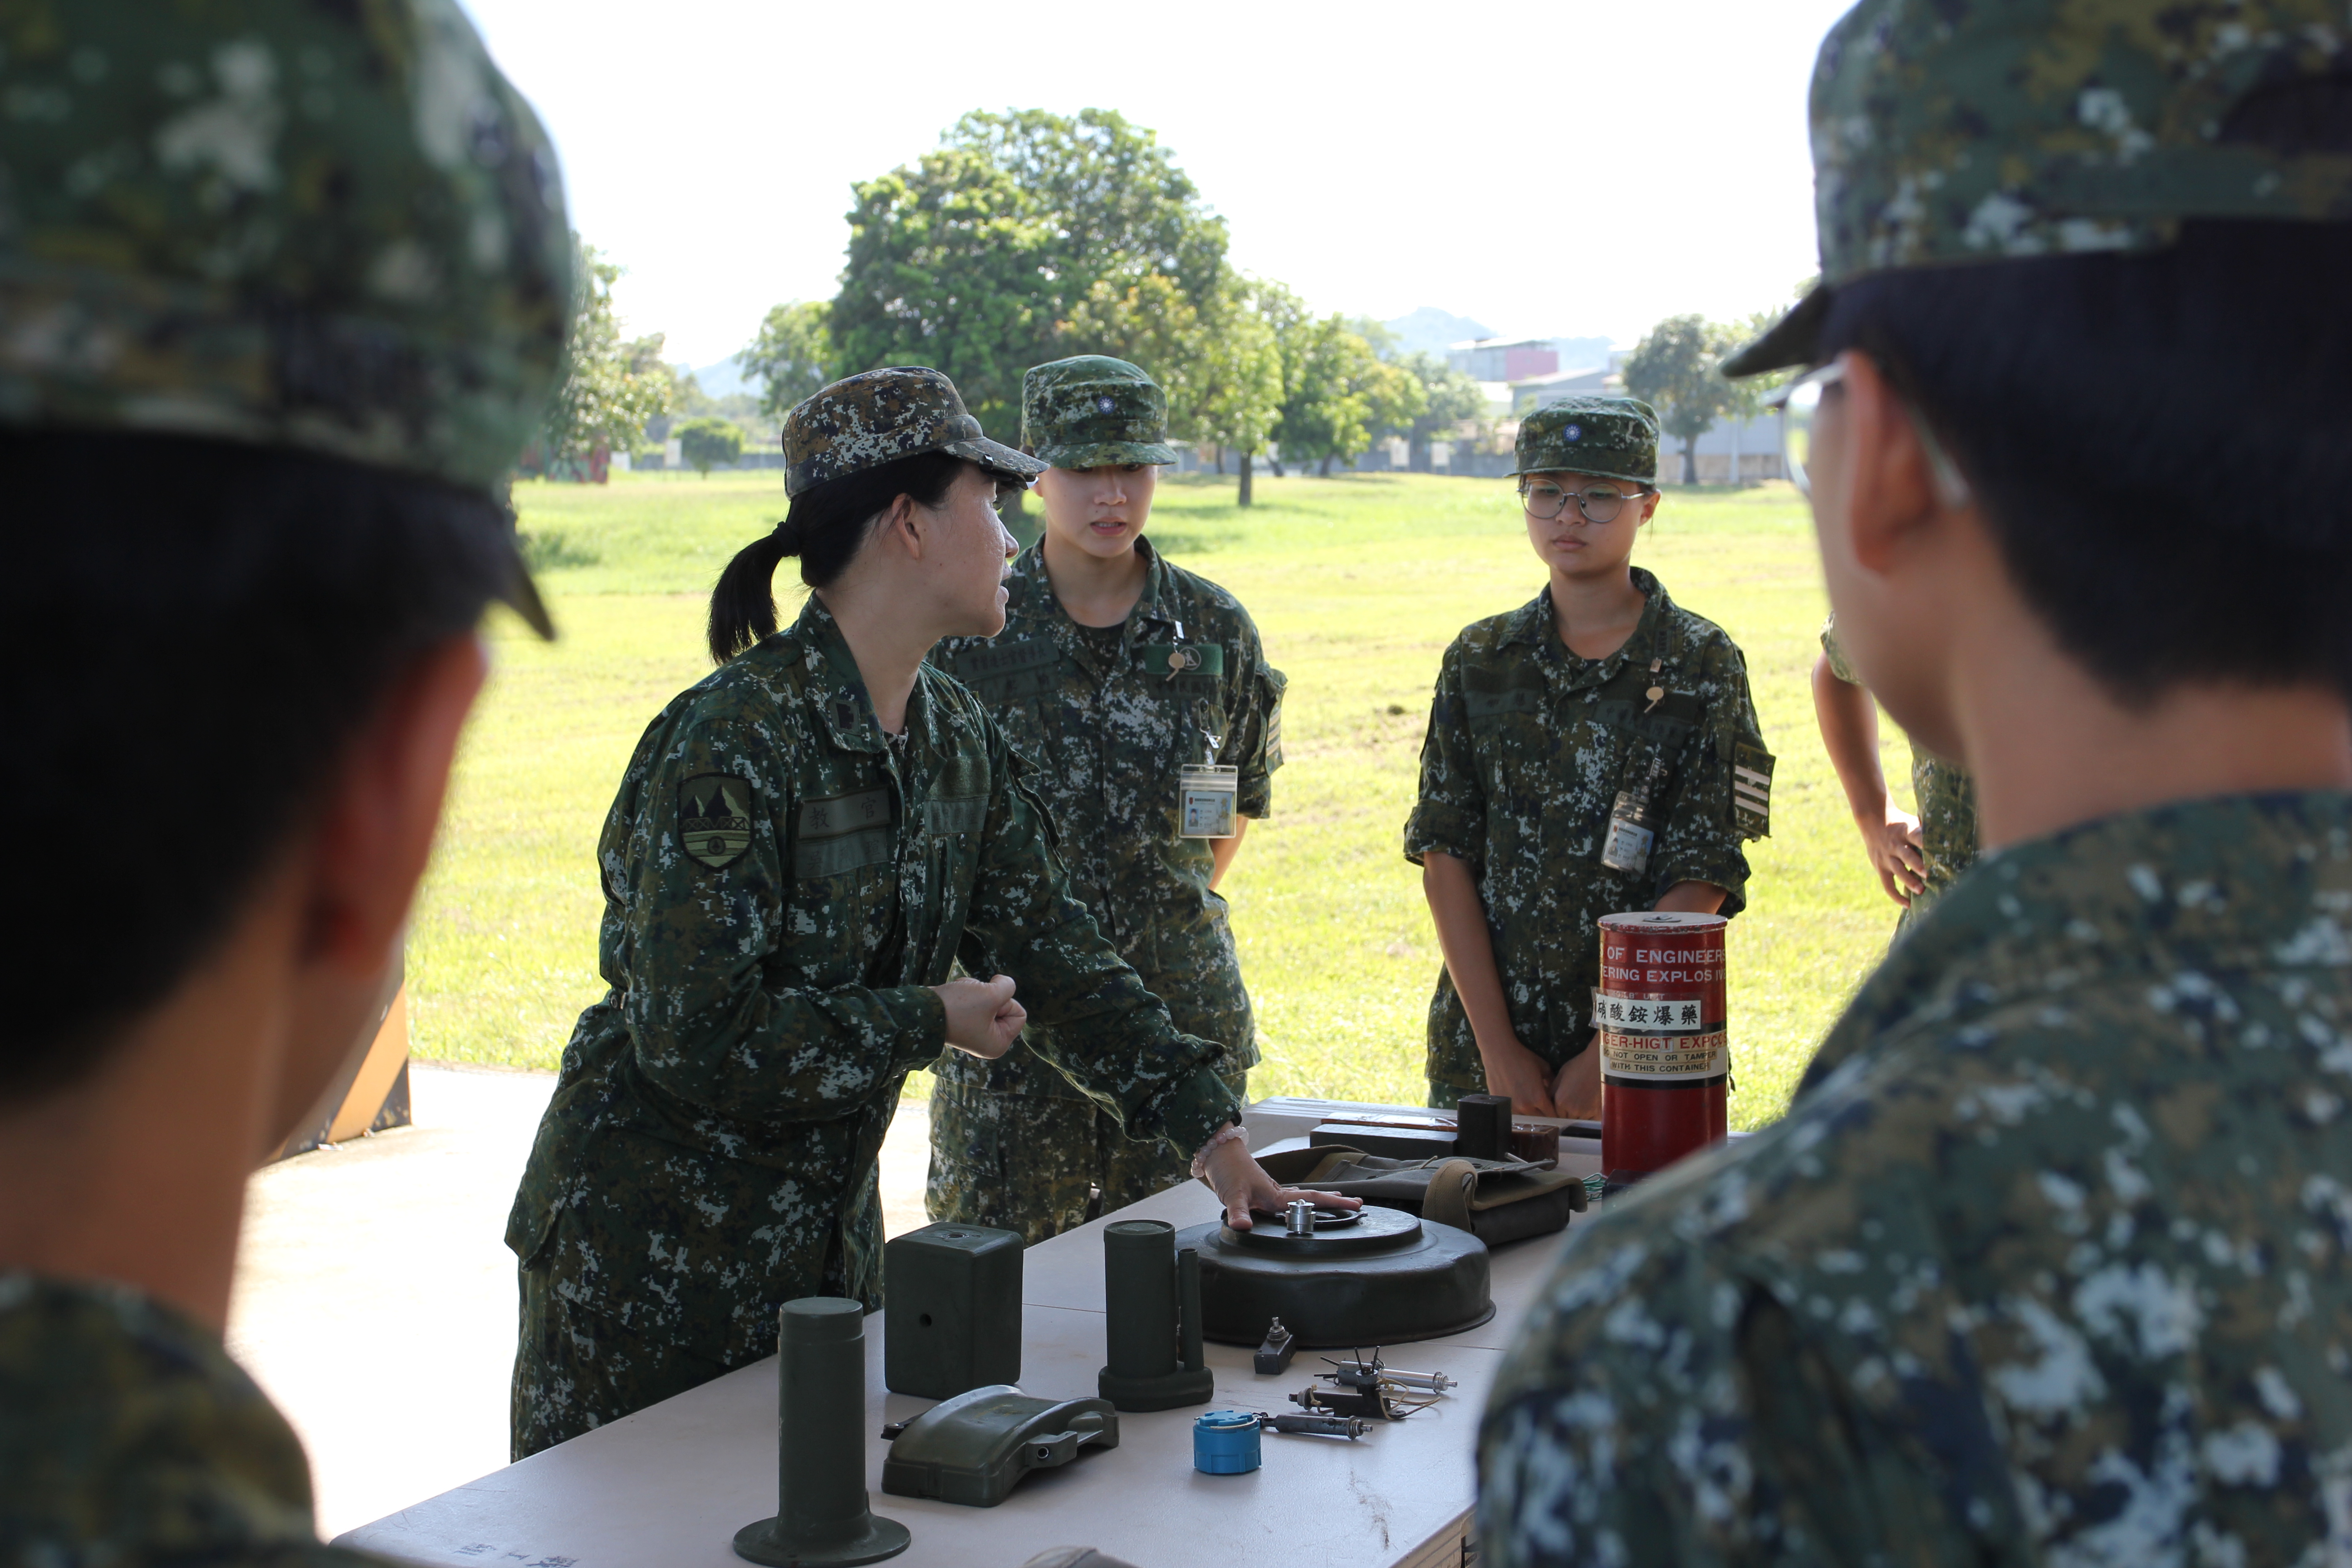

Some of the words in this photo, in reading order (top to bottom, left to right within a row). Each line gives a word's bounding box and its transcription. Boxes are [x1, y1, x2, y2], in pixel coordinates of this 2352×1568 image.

[808, 797, 877, 830] 教官
[1607, 946, 1625, 960] OF
[1636, 949, 1726, 964] ENGINEERS
[1597, 999, 1697, 1026] 硝酸銨爆藥
[1603, 1033, 1672, 1049] GER-HIGT
[1613, 1051, 1628, 1059] NOT
[1684, 1050, 1716, 1061] TAMPER
[1611, 1061, 1631, 1070] WITH
[1659, 1062, 1709, 1073] CONTAINER
